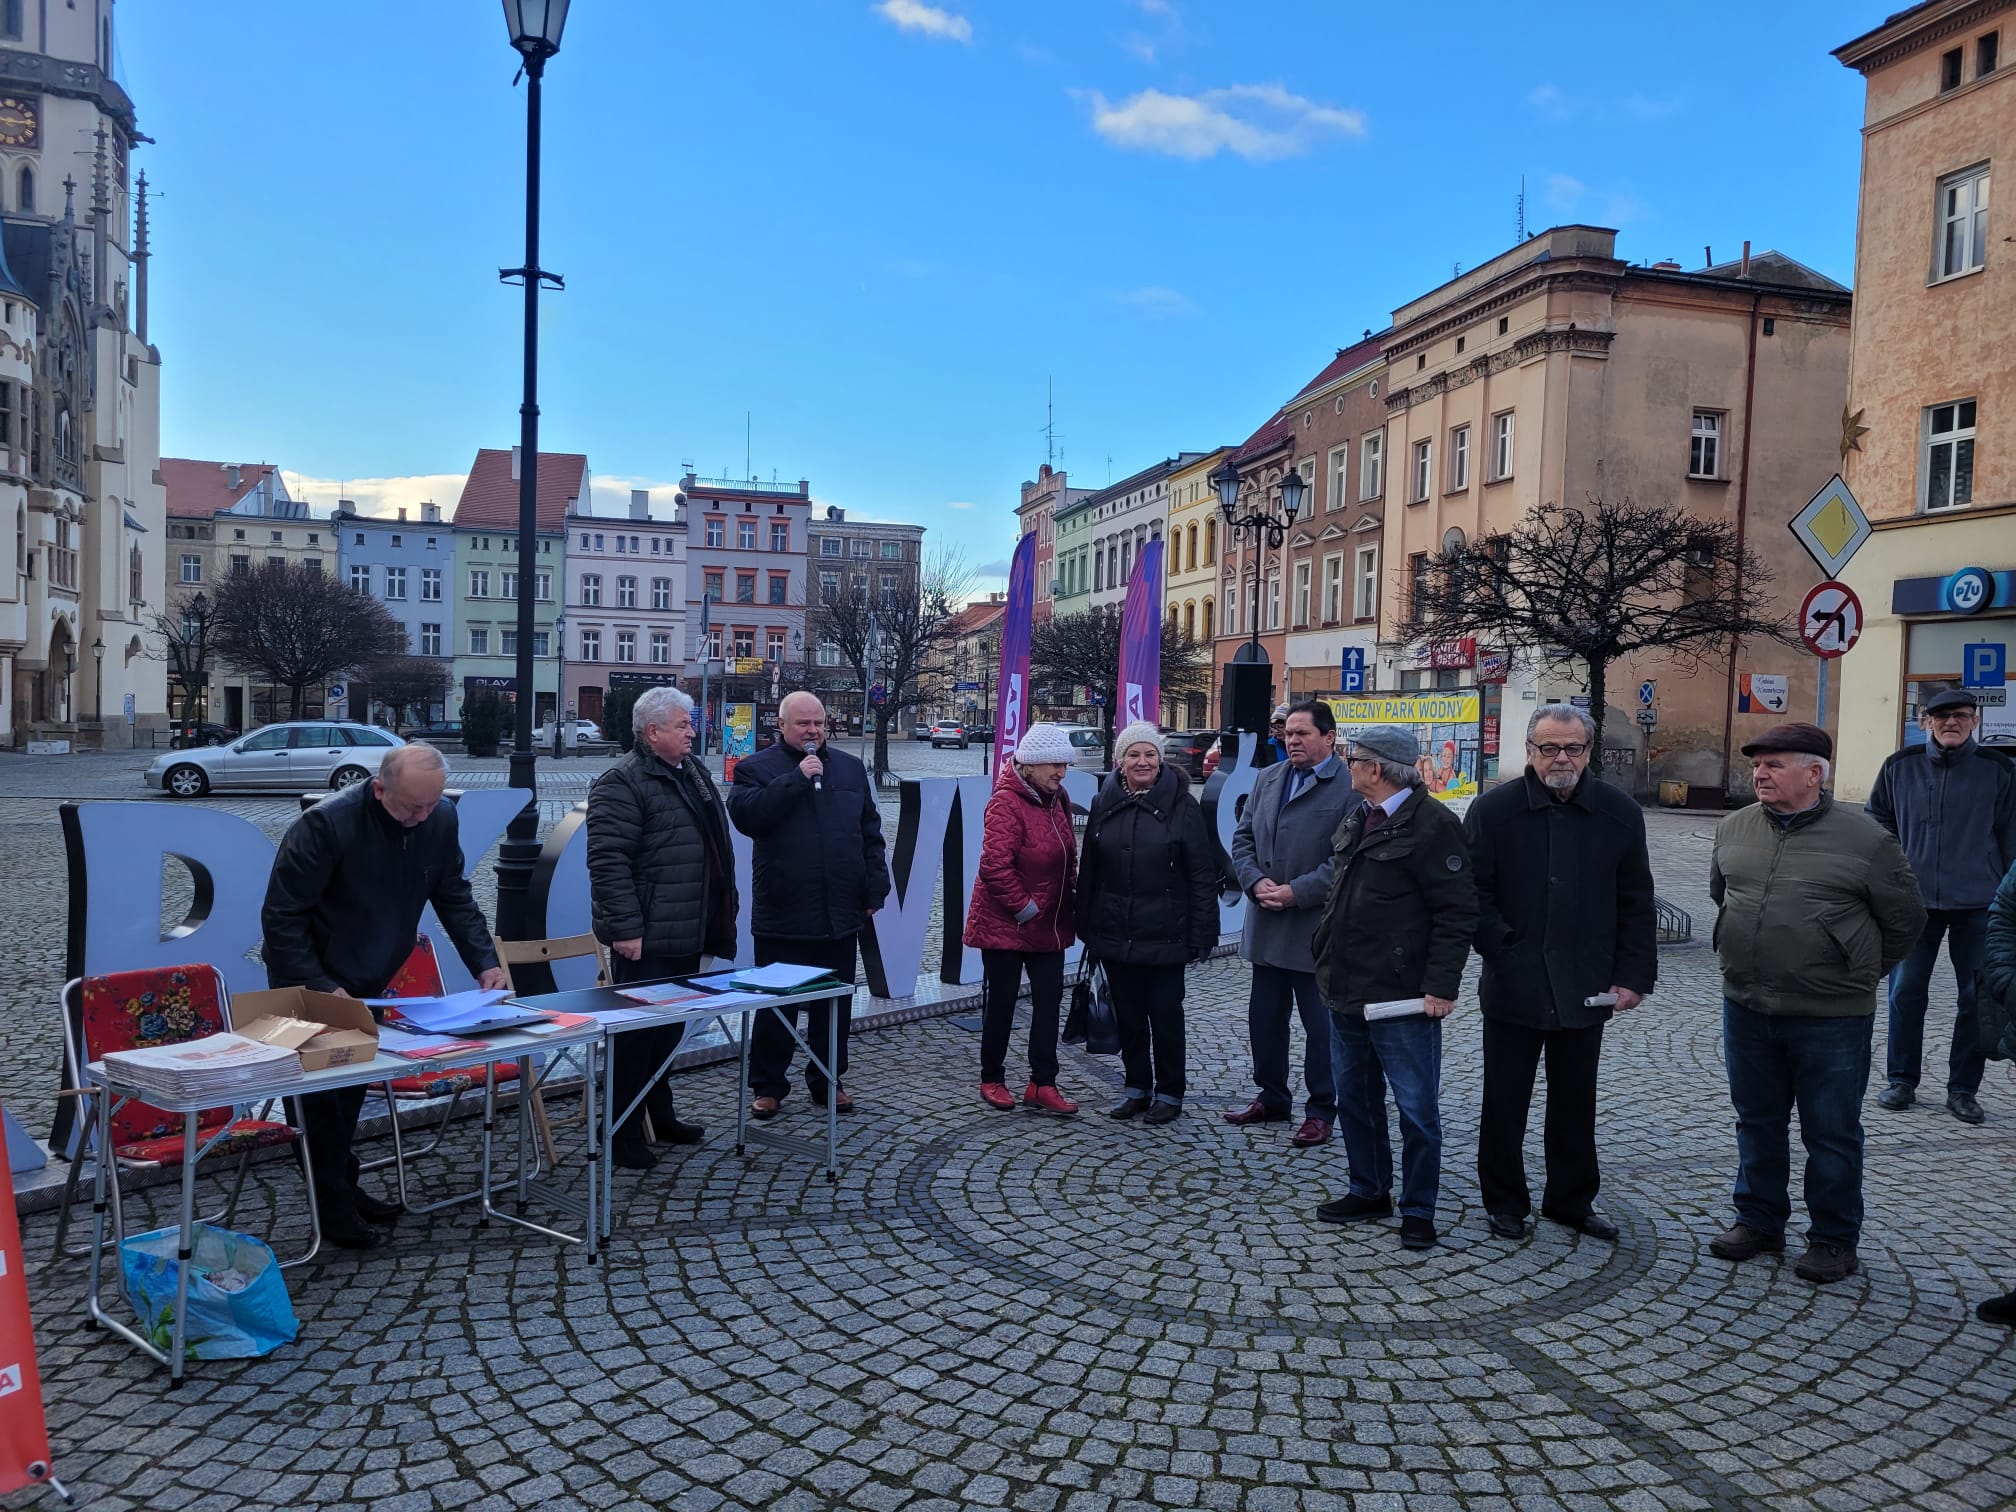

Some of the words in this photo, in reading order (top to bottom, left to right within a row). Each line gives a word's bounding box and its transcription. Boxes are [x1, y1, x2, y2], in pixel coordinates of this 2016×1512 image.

[1955, 580, 1980, 602] PZU
[1973, 648, 1997, 682] P
[476, 679, 510, 687] PLAY
[1346, 673, 1360, 691] P
[1972, 691, 2005, 703] oniec
[1334, 702, 1383, 719] ONECZNY
[1385, 701, 1415, 719] PARK
[1418, 700, 1464, 719] WODNY
